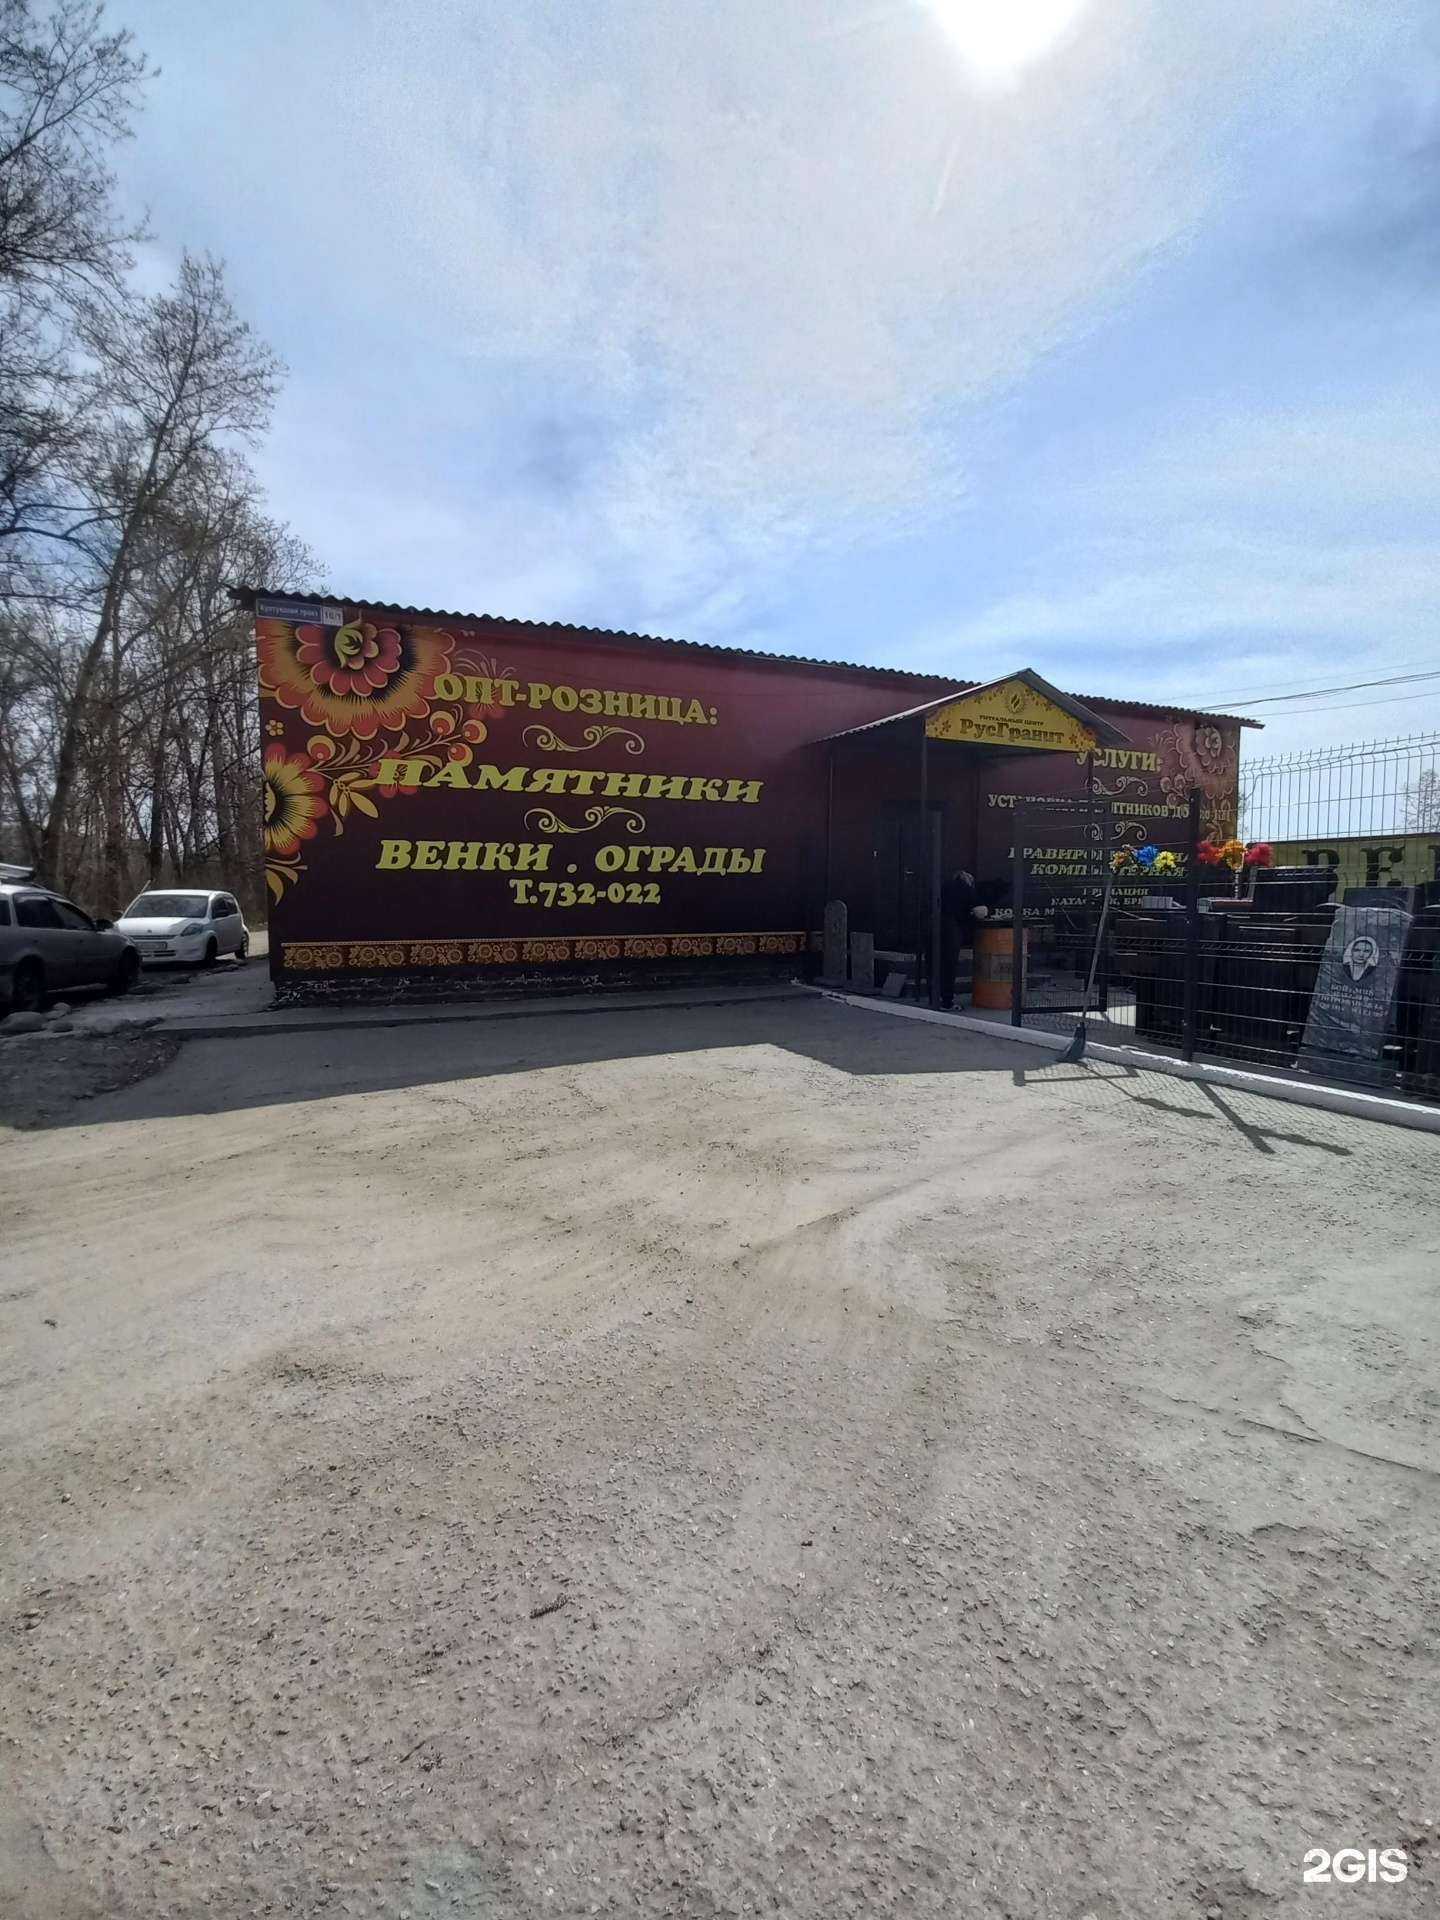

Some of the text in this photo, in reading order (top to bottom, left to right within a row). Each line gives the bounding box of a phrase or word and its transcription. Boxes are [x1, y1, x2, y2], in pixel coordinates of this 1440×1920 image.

[434, 673, 718, 725] ОПТ-РОЗНИЦА:
[960, 718, 1065, 744] РусГранит
[376, 759, 764, 803] ПАМЯТНИКИ
[375, 840, 554, 871] ВЕНКИ
[595, 845, 767, 876] ОГРАДЫ
[509, 879, 662, 907] Т.732-022
